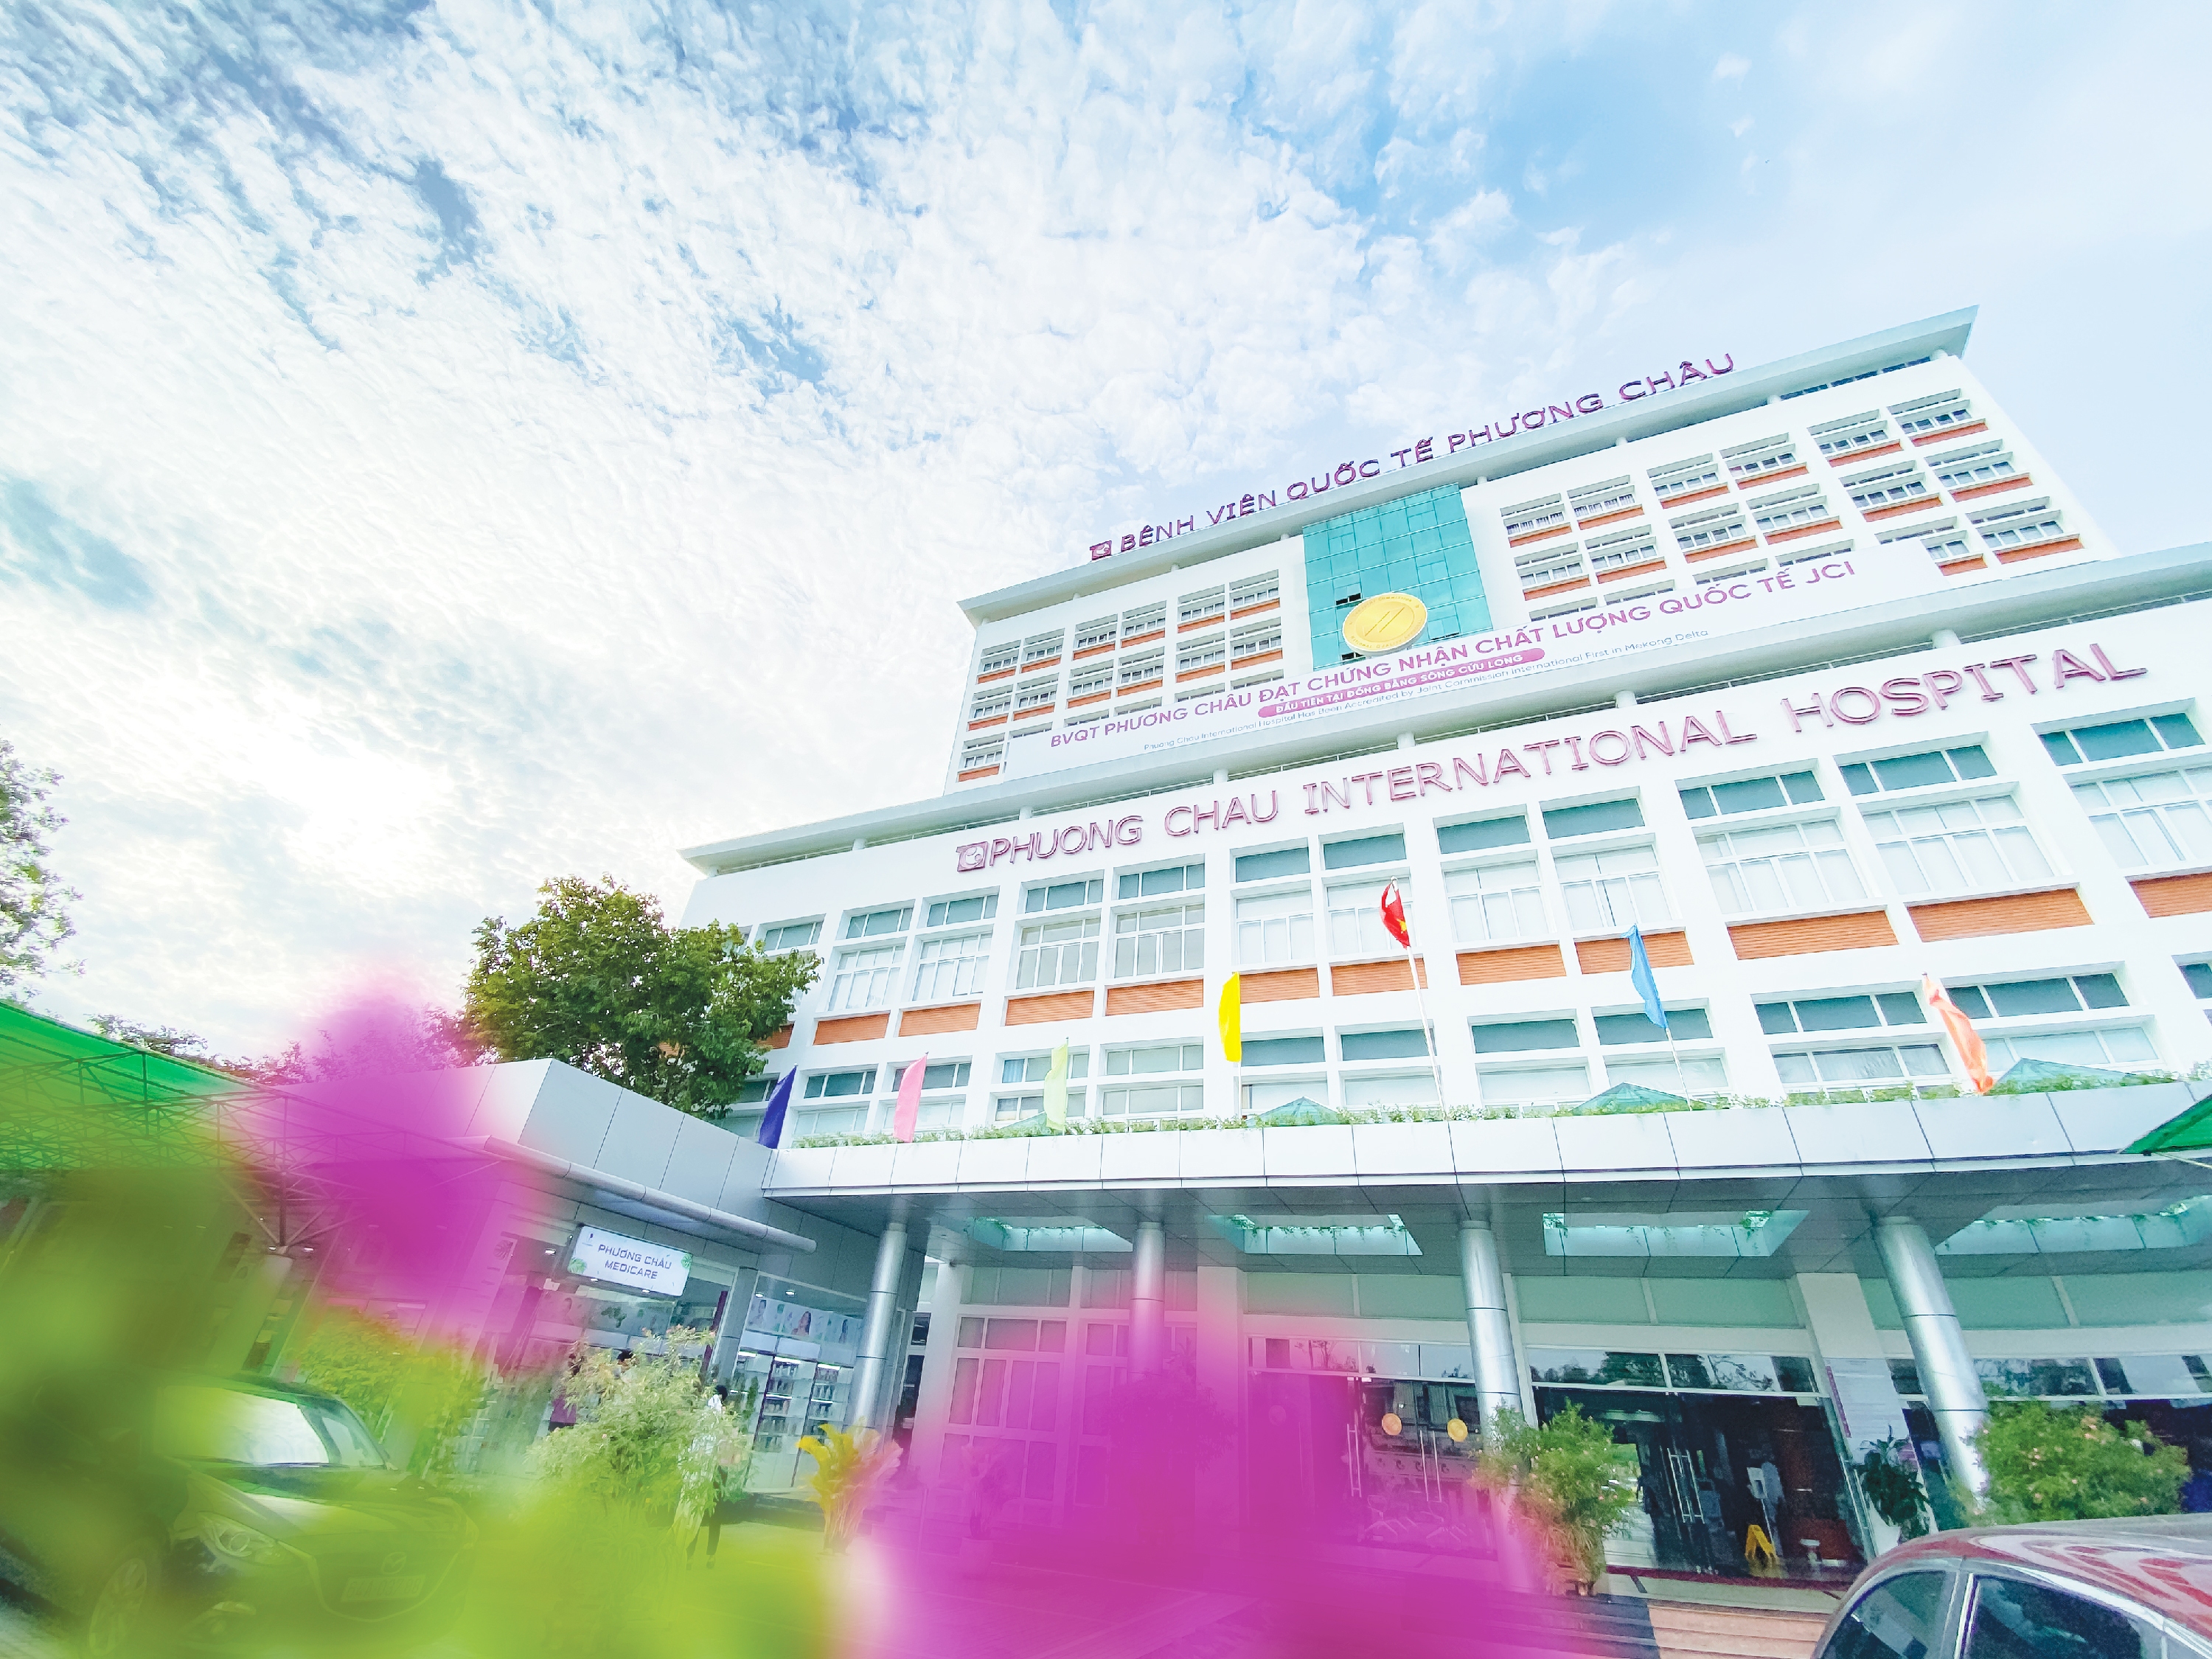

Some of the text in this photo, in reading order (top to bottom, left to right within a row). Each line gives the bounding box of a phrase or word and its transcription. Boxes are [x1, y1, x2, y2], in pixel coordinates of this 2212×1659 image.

[1287, 459, 1381, 500] QUỐC
[1390, 437, 1433, 468] TẾ
[1447, 393, 1604, 453] PHƯƠNG
[1618, 353, 1734, 400] CHÂU
[1050, 560, 1856, 748] BVQT PHƯƠNG CHÂU ĐẠT CHỨNG NHẬN CHẤT LƯỢNG QUỐC TẾ JCI
[1201, 722, 1256, 739] International
[1259, 713, 1295, 728] Hospital
[1298, 710, 1315, 719] Has
[1344, 692, 1399, 710] Accredited
[1416, 684, 1442, 694] Joint
[1444, 670, 1509, 688] Commission
[1511, 654, 1583, 675] International
[1585, 649, 1610, 661] First
[1612, 646, 1622, 654] in
[1624, 636, 1673, 653] Mekong
[1674, 630, 1708, 641] Delta
[1487, 654, 1523, 669] LONG
[987, 642, 2149, 867] PHUONG CHAU INTERNATIONAL HOSPITAL
[604, 1259, 659, 1279] MEDICARE
